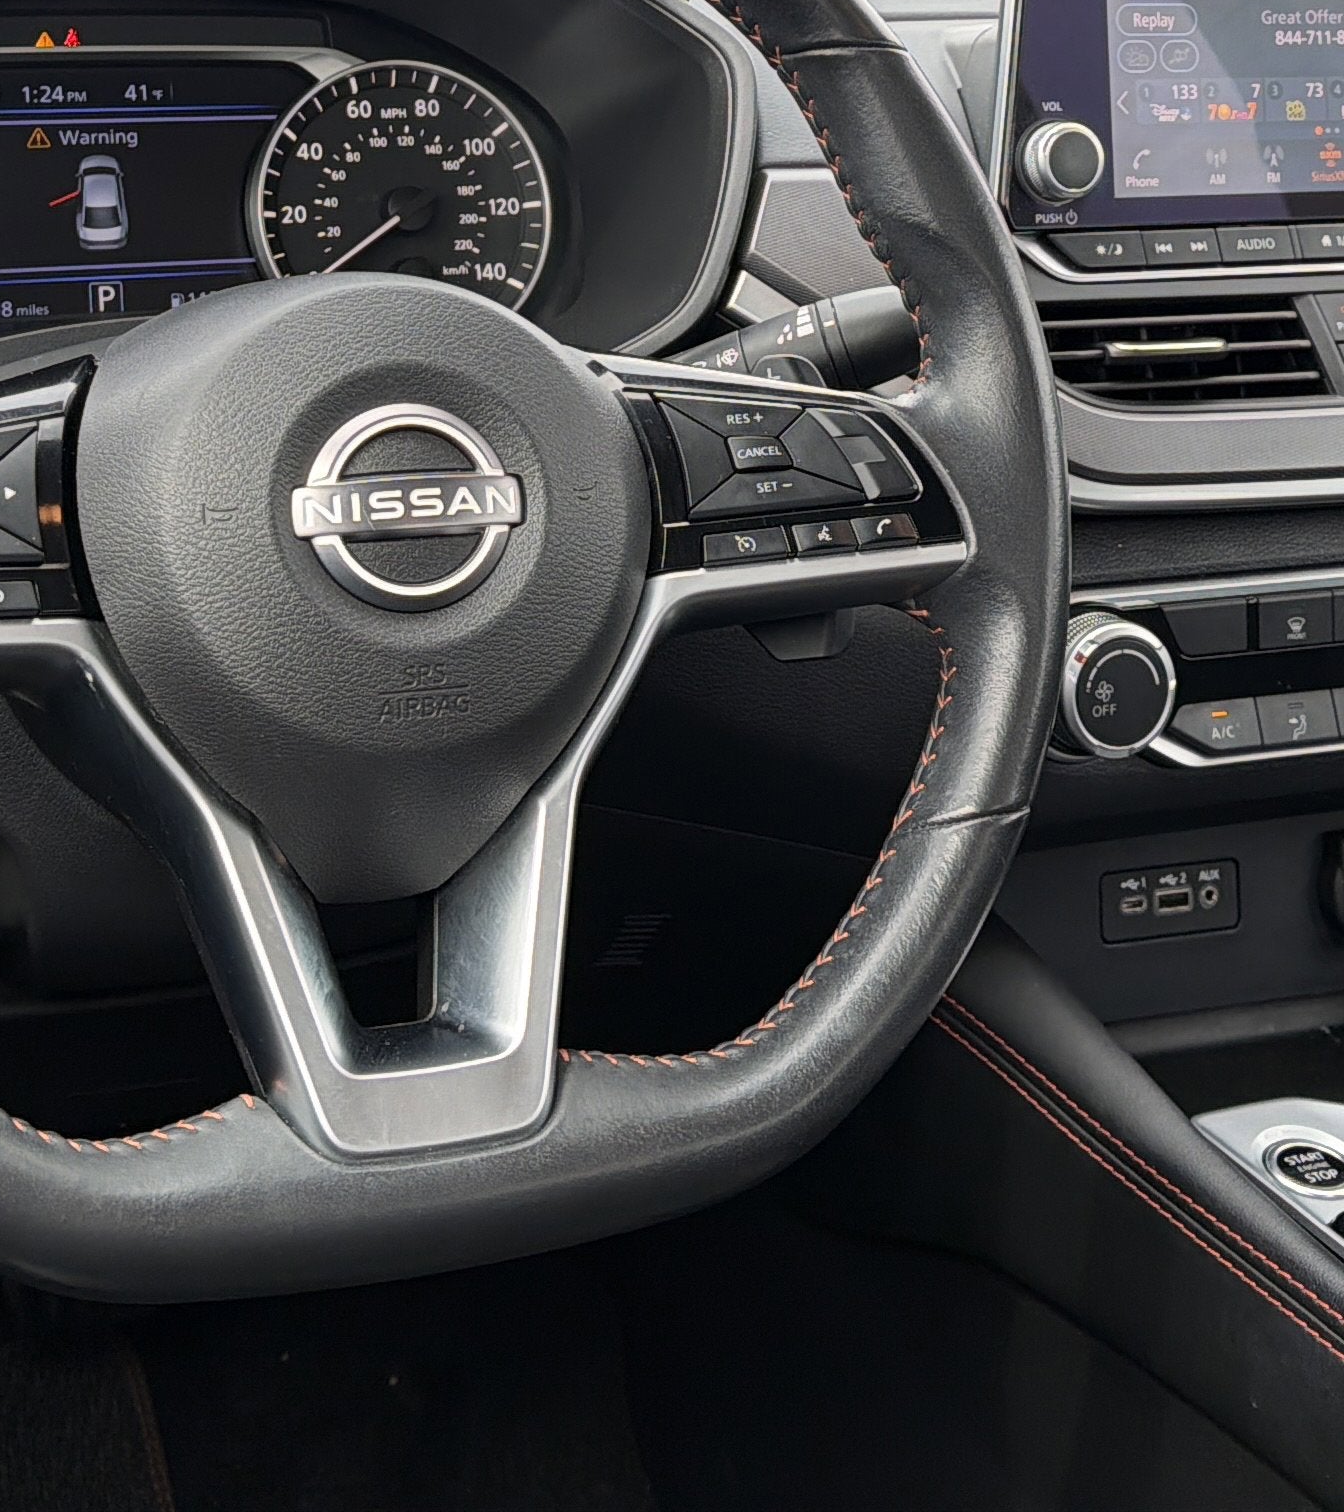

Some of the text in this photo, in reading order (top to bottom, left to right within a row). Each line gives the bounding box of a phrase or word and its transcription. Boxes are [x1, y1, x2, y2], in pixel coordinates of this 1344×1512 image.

[1133, 12, 1175, 31] Replay
[1261, 10, 1301, 25] Great
[1305, 9, 1343, 25] Offer
[21, 85, 87, 104] 1:24 PM
[124, 84, 148, 102] 41
[1172, 84, 1198, 100] 133
[1251, 83, 1261, 98] 7
[1271, 85, 1279, 96] 3
[1306, 83, 1324, 98] 73
[1333, 83, 1342, 94] 4
[346, 99, 372, 119] 60
[380, 106, 407, 120] MPH
[414, 98, 440, 118] 80
[1042, 101, 1063, 112] VOL
[58, 129, 139, 148] Warning
[368, 136, 388, 148] 100
[397, 135, 415, 147] 120
[296, 142, 323, 161] 40
[424, 143, 443, 155] 140
[462, 138, 495, 157] 100
[345, 151, 361, 163] 80
[441, 160, 460, 172] 160
[331, 170, 346, 182] 60
[1125, 175, 1160, 187] Phone
[1209, 174, 1226, 185] AM
[1267, 172, 1281, 183] FM
[457, 185, 475, 197] 180
[323, 197, 338, 208] 40
[488, 197, 520, 216] 120
[280, 205, 307, 224] 20
[458, 213, 478, 225] 200
[1035, 212, 1063, 225] PUSH
[326, 226, 341, 238] 20
[453, 239, 473, 251] 220
[1237, 238, 1276, 251] AUDIO
[442, 263, 469, 277] km/h
[474, 262, 506, 281] 140
[97, 285, 116, 313] P
[16, 304, 50, 316] miles
[726, 412, 751, 425] RES
[736, 445, 783, 460] CANCEL
[756, 481, 778, 494] SET
[304, 485, 516, 528] NISSAN
[403, 663, 447, 687] SRS
[380, 693, 471, 724] AIRBAG
[1092, 703, 1118, 718] OFF
[1211, 726, 1236, 740] A/C
[1140, 876, 1147, 889] 1
[1179, 871, 1187, 884] 2
[1198, 869, 1221, 882] AUX
[1283, 1151, 1325, 1167] START
[1304, 1168, 1338, 1184] STOP
